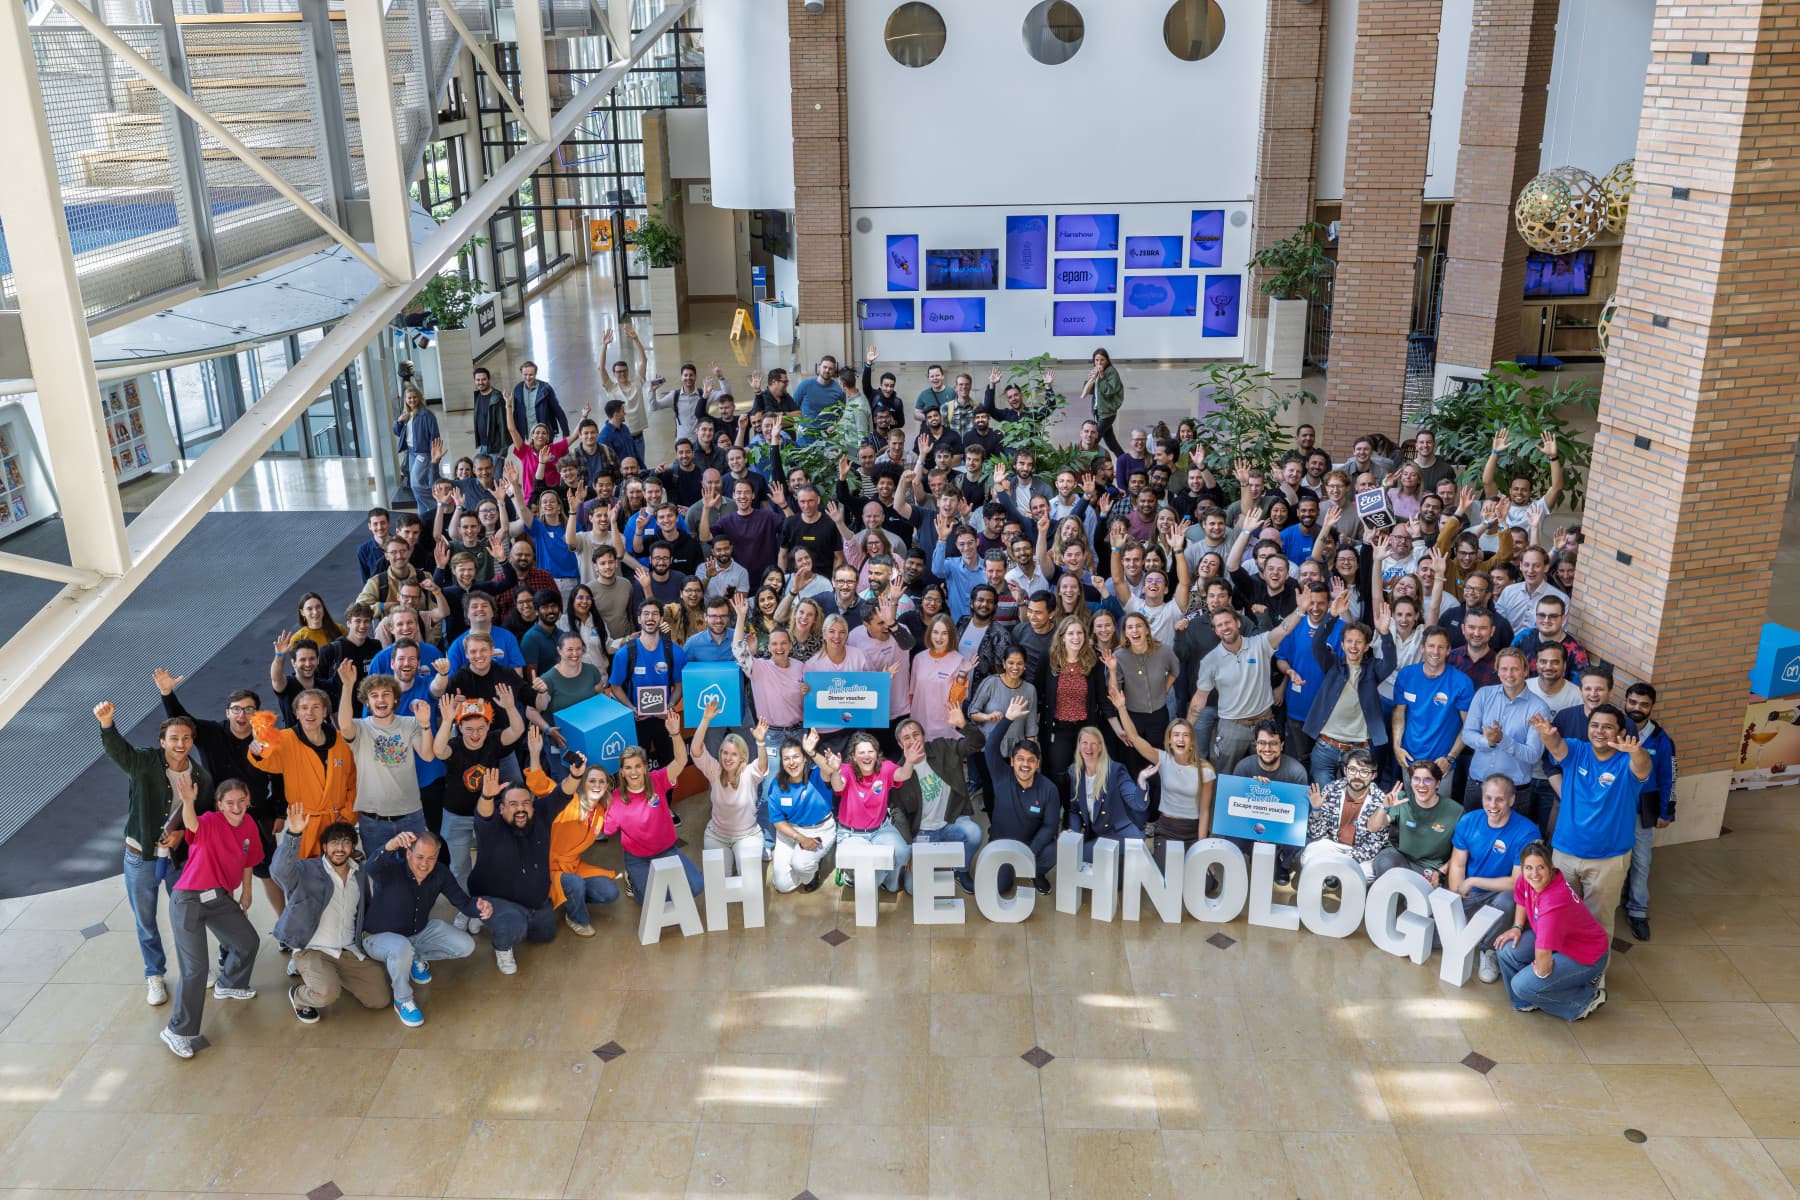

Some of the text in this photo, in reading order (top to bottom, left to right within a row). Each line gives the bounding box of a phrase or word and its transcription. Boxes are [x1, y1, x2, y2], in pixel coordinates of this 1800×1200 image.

[939, 313, 955, 321] kpn
[1360, 494, 1382, 507] Etos
[641, 691, 664, 705] Etos
[1233, 801, 1252, 810] Escape
[1268, 807, 1290, 815] voucher
[638, 831, 1504, 987] AH TECHNOLOGY
